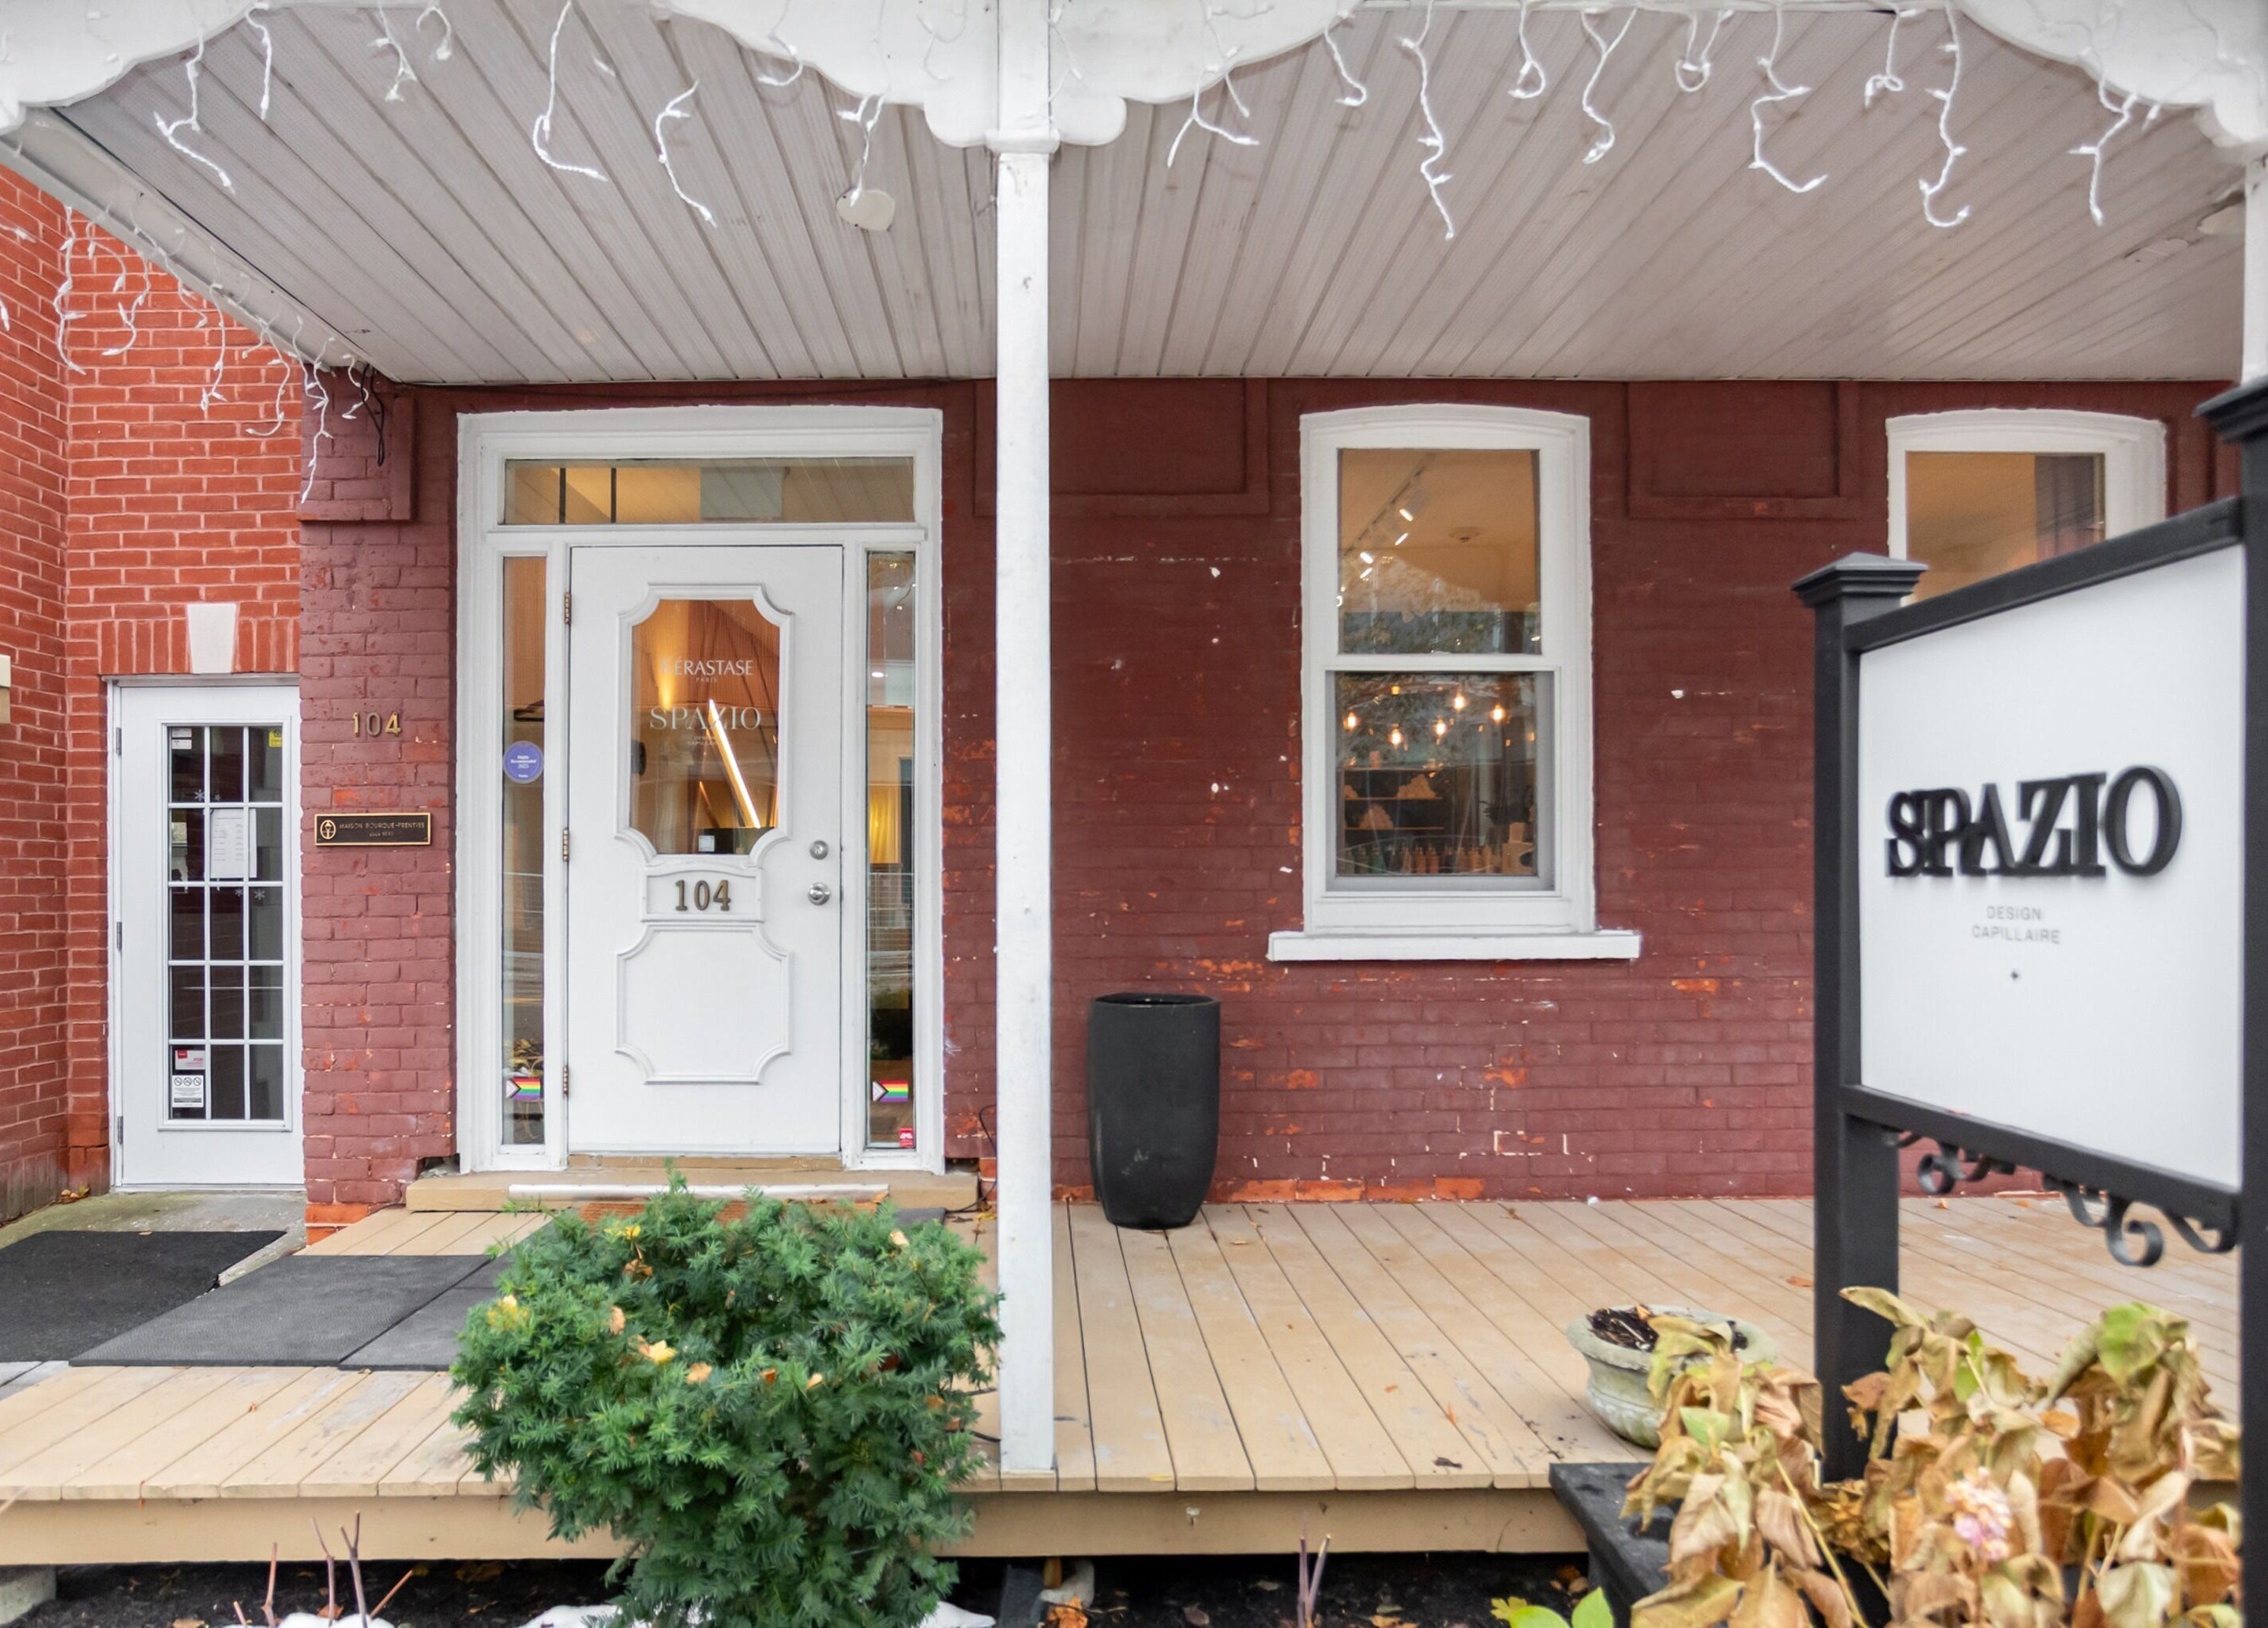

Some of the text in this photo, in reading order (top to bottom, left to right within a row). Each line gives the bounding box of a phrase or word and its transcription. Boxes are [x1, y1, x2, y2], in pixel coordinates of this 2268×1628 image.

[352, 712, 401, 737] 104
[650, 706, 761, 730] SPAZIO
[1884, 765, 2183, 878] SPAZIO
[675, 879, 731, 911] 104
[1987, 904, 2042, 922] DESIGN
[1972, 924, 2060, 945] CAPILLAIRE
